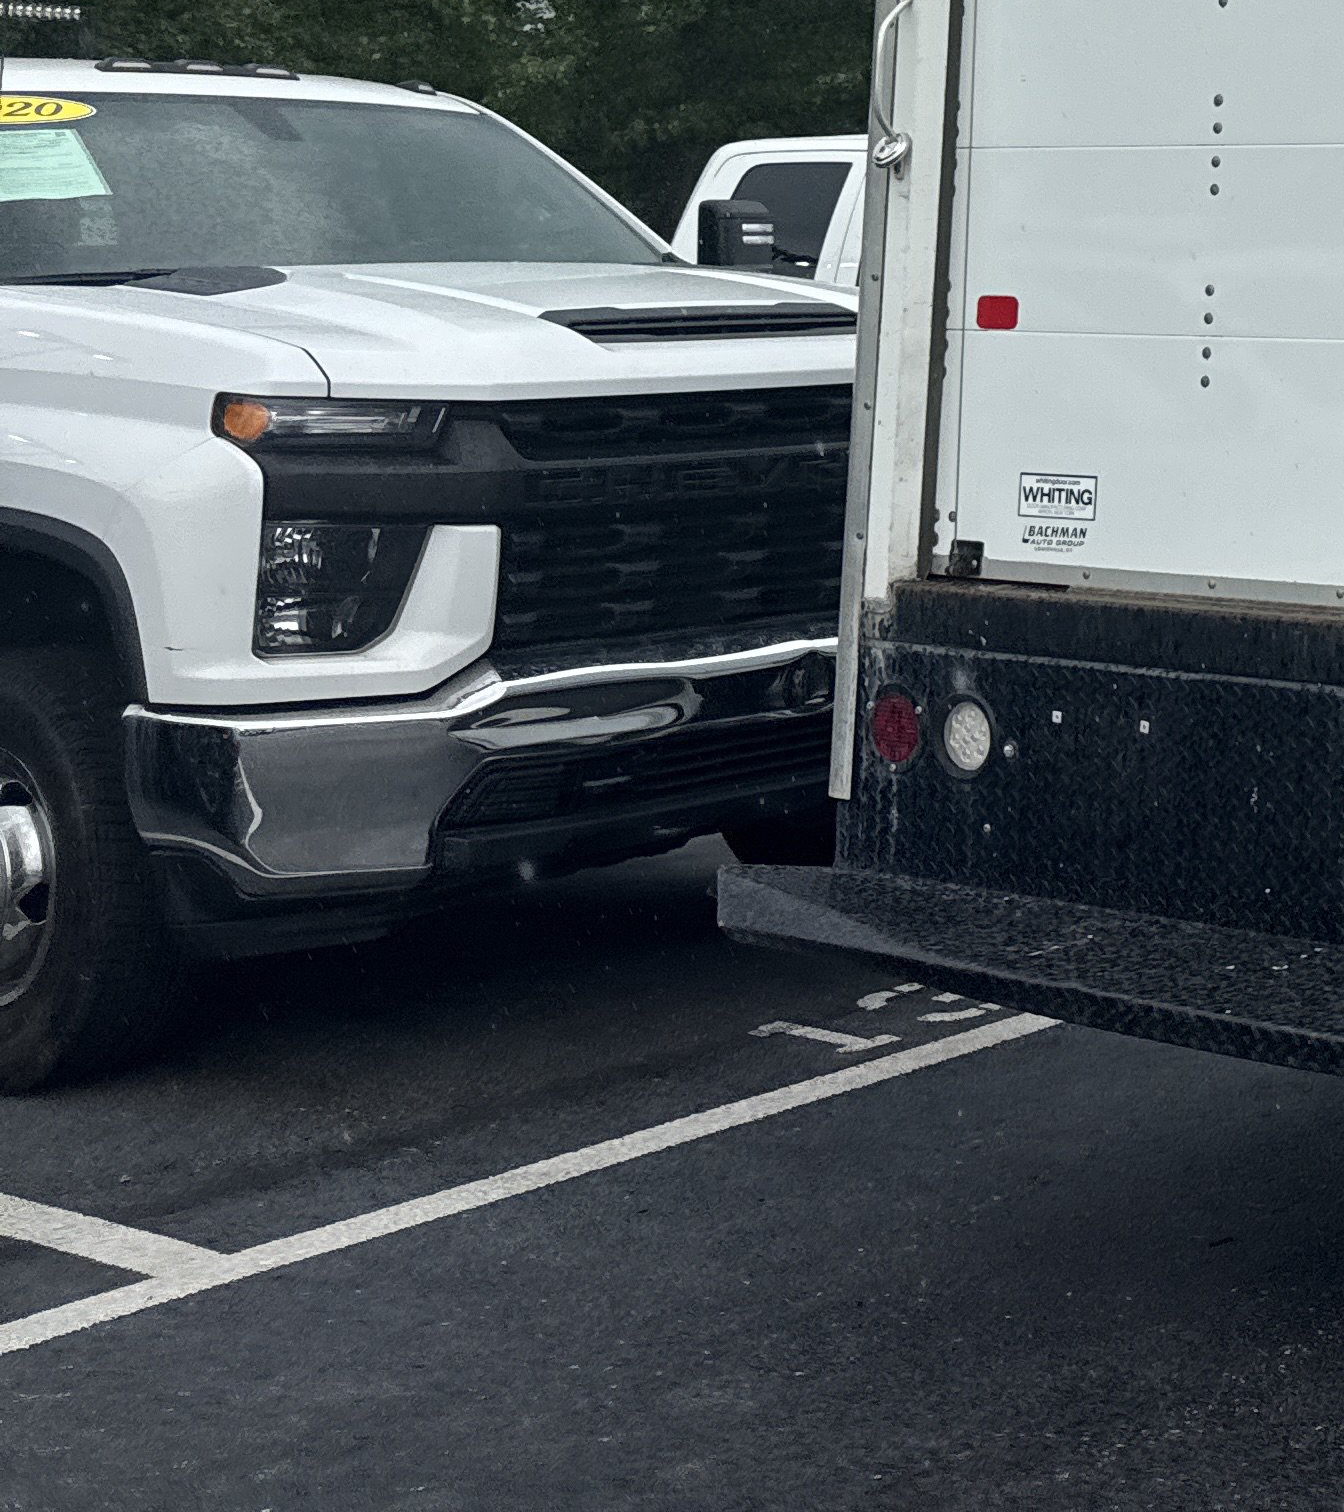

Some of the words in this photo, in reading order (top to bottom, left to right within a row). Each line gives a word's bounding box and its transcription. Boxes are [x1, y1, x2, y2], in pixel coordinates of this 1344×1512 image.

[0, 100, 63, 117] 20
[1023, 486, 1092, 505] WHITING
[1028, 525, 1087, 538] BACHMAN
[1030, 538, 1053, 546] AUTO
[1055, 539, 1085, 547] GROUP
